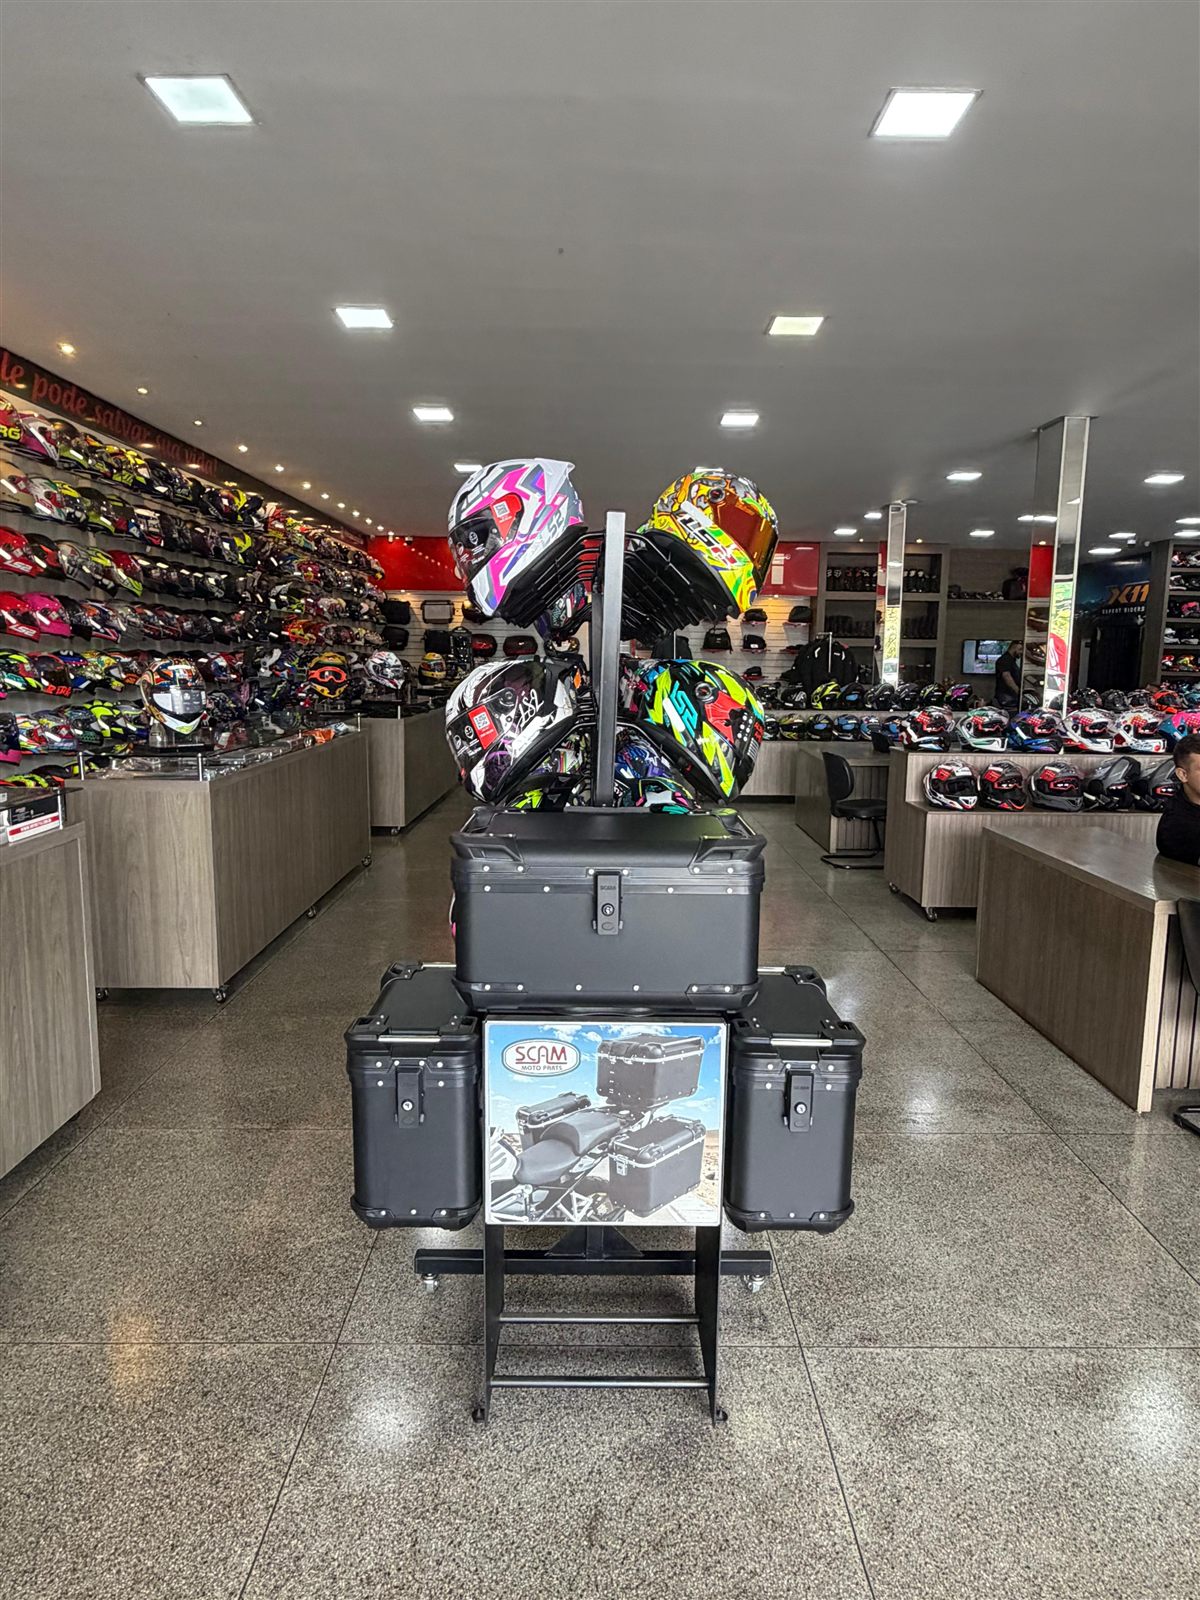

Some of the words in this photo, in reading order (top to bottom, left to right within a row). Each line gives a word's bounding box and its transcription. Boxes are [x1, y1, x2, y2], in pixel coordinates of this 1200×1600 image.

[32, 373, 87, 415] pode
[95, 404, 149, 441] salvar
[3, 560, 33, 573] LS2
[1105, 581, 1150, 604] X11
[8, 623, 37, 637] LS2
[517, 688, 545, 724] LS2
[670, 680, 698, 739] LS2
[515, 1045, 567, 1064] SCAM
